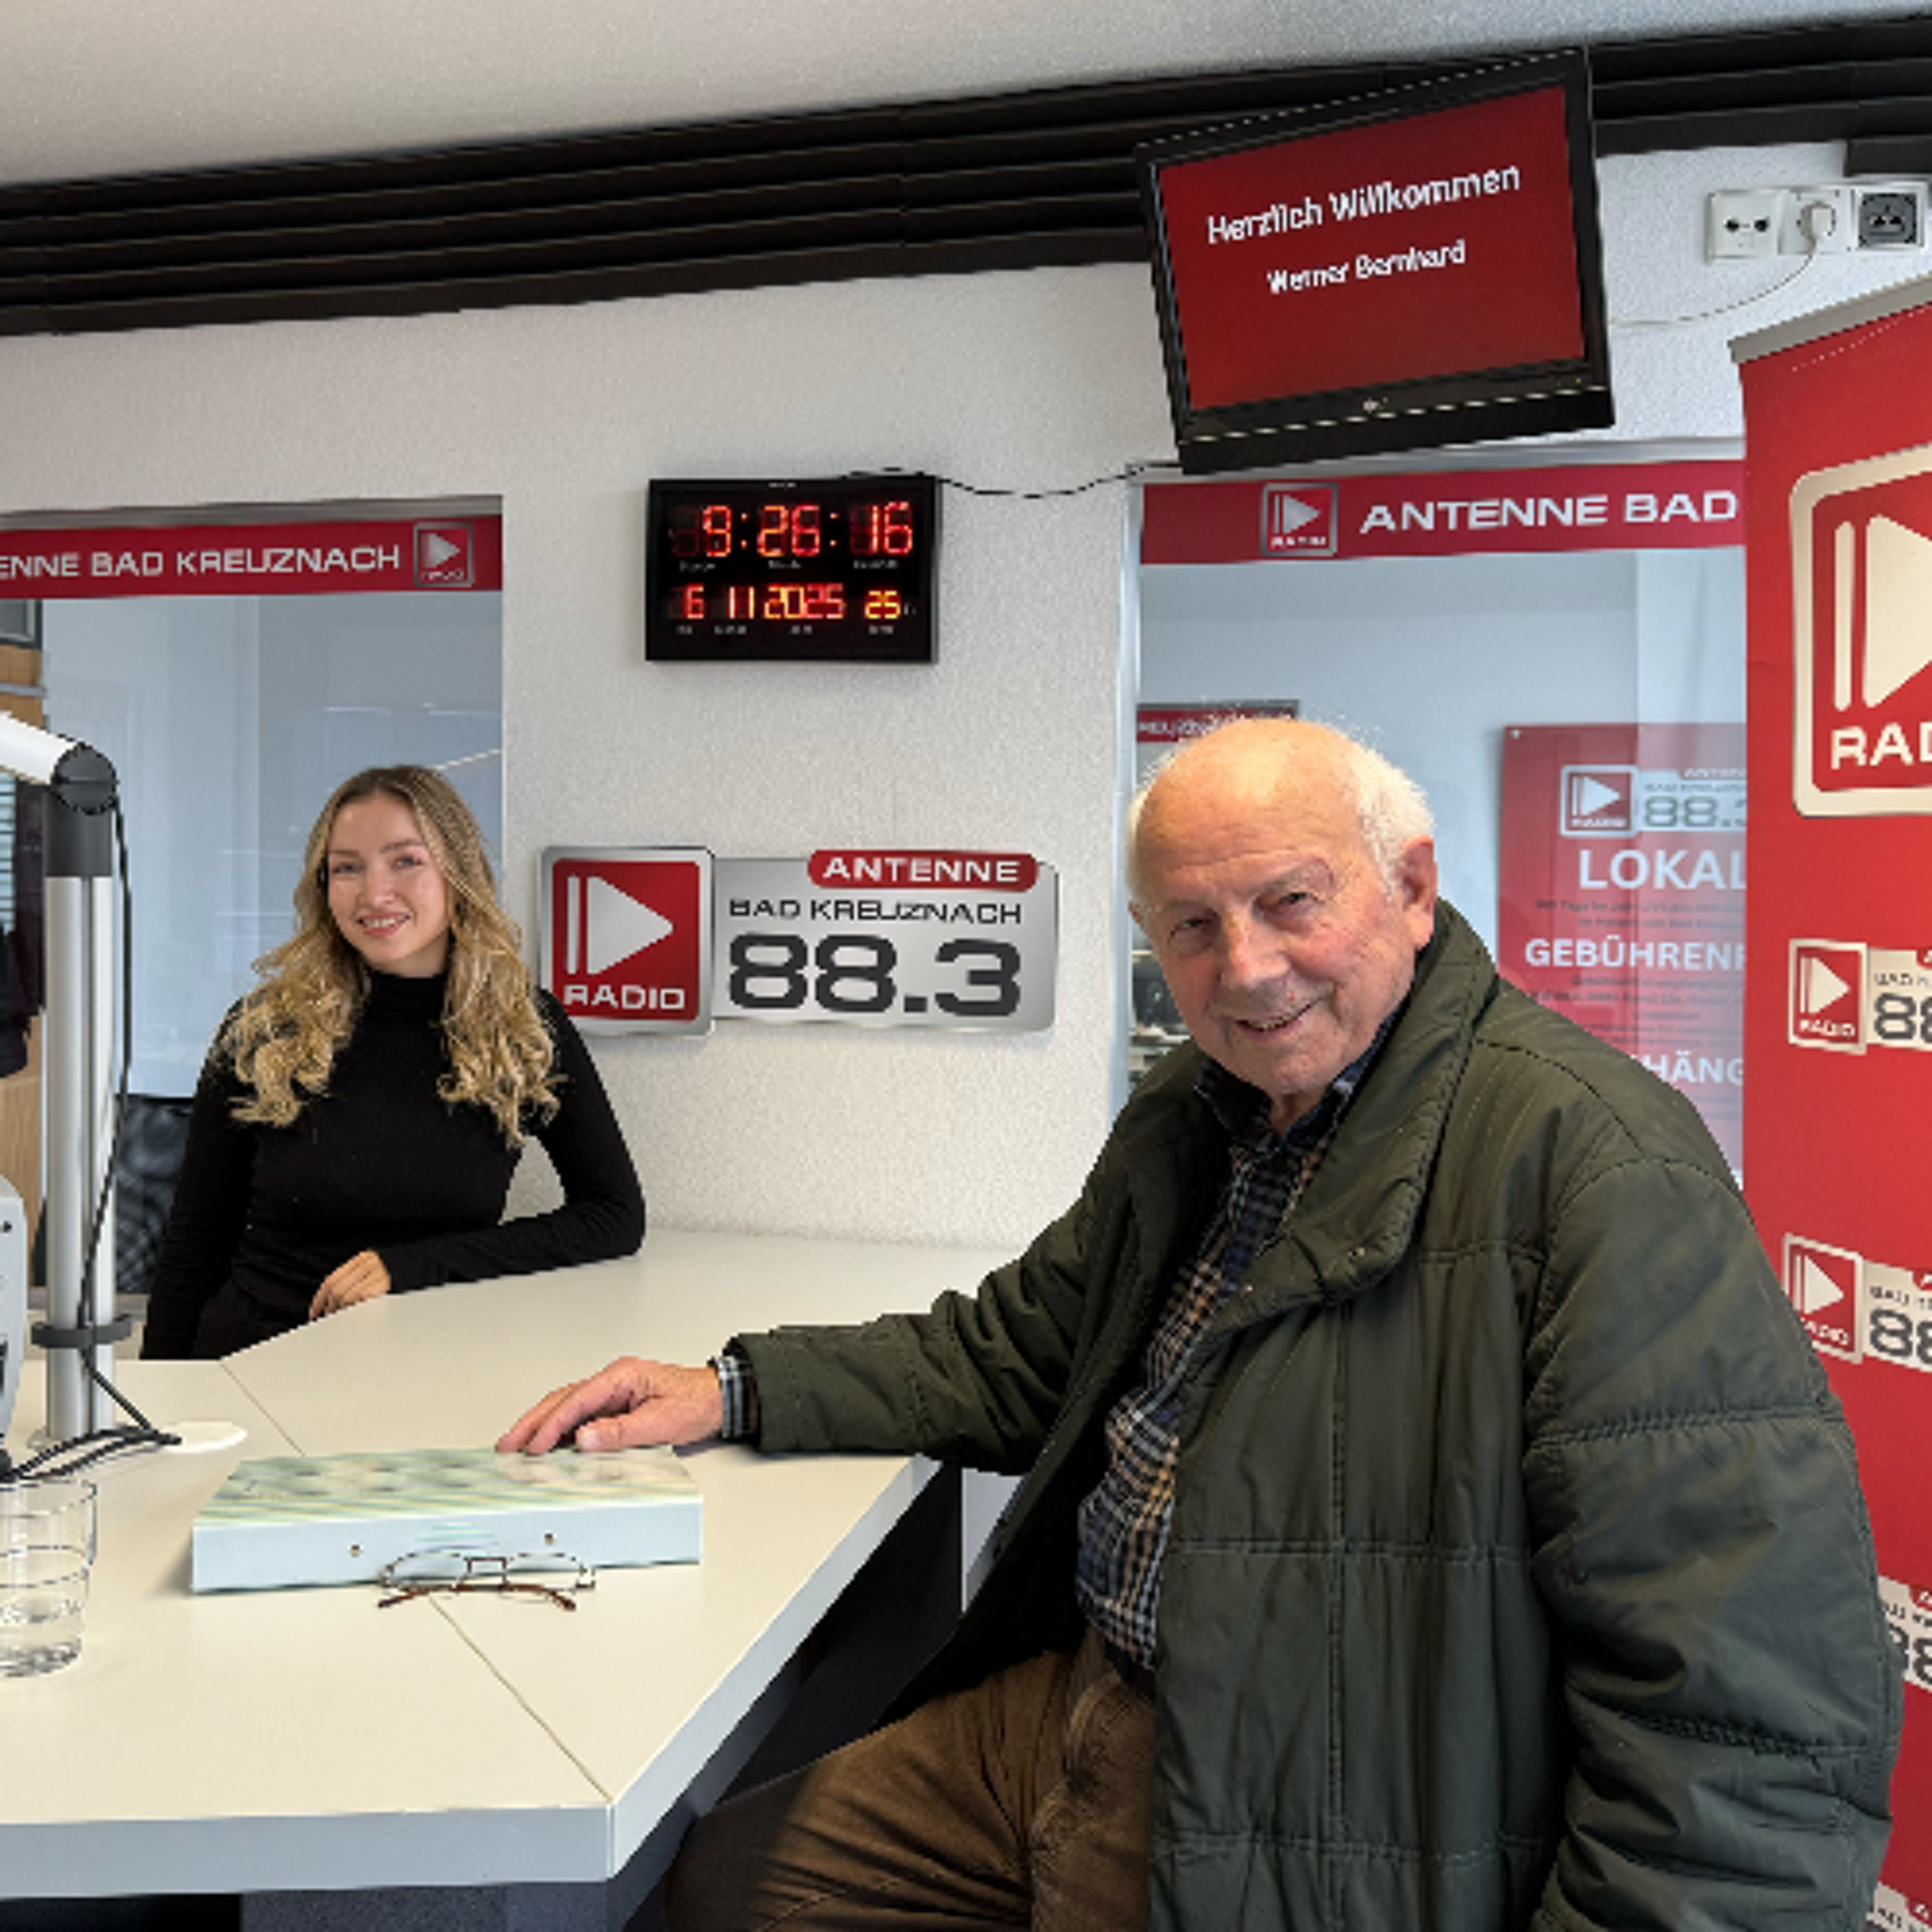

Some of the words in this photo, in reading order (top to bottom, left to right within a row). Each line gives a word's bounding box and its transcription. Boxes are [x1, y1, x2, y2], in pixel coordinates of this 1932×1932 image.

[1207, 196, 1323, 245] Herzlich
[1328, 165, 1520, 221] Willkommen
[1266, 261, 1350, 294] Werner
[1355, 238, 1466, 279] Bernhard
[1359, 494, 1609, 534] ANTENNE
[1624, 490, 1737, 523] BAD
[0, 552, 80, 580] ENNE
[91, 551, 164, 576] BAD
[176, 545, 400, 574] KREUZNACH
[822, 857, 1020, 882] ANTENNE
[1579, 848, 1746, 890] LOKAL
[729, 898, 801, 918] BAD
[810, 900, 1022, 924] KREUZNACH
[728, 931, 1022, 1018] 88.3
[564, 984, 685, 1010] RADIO
